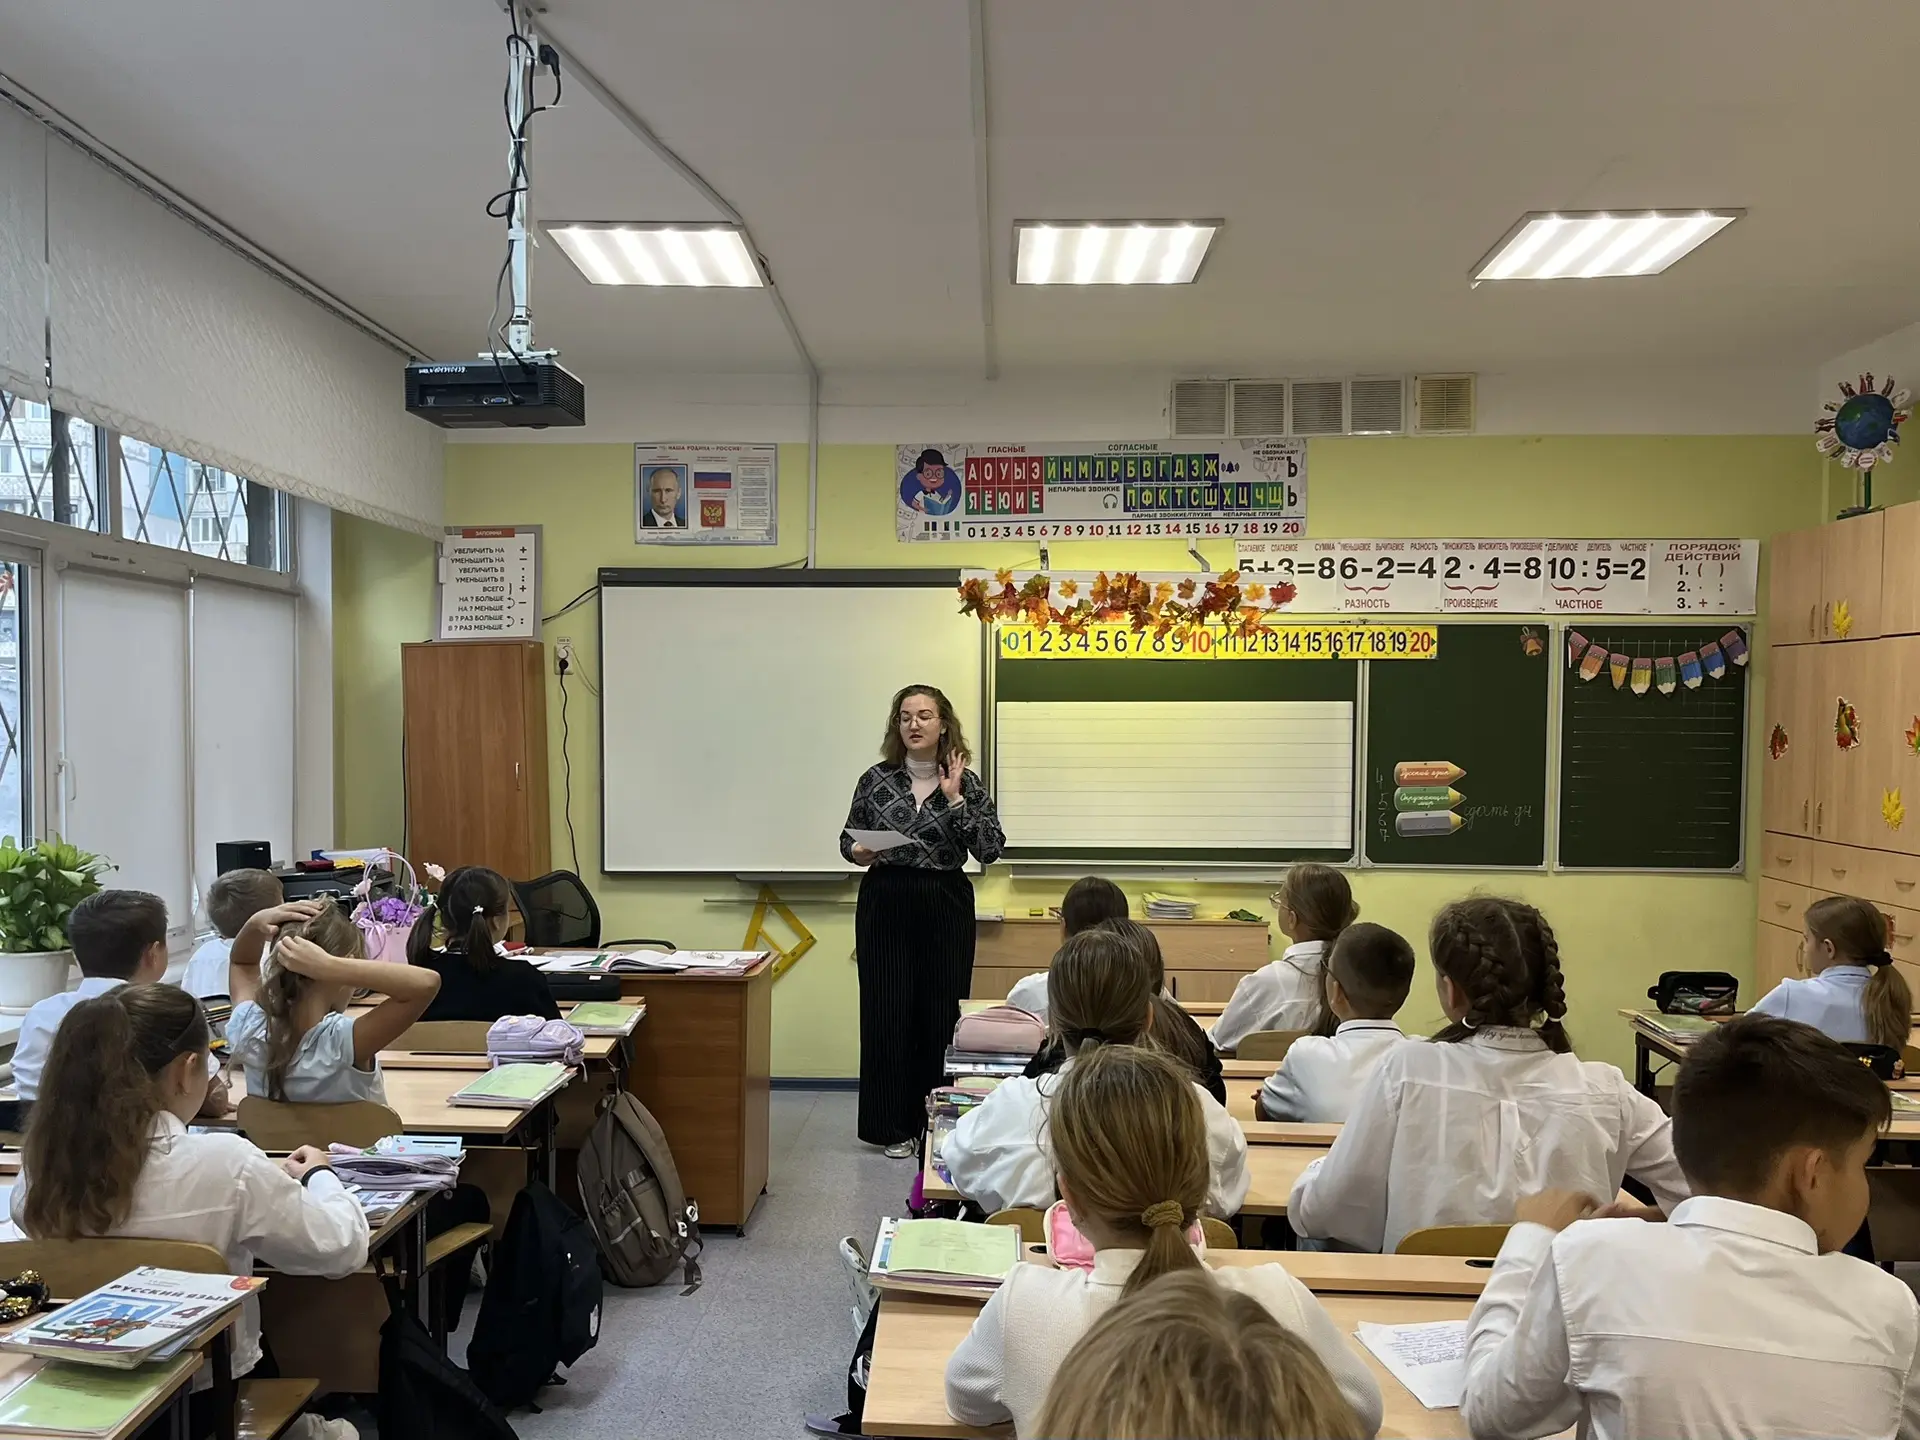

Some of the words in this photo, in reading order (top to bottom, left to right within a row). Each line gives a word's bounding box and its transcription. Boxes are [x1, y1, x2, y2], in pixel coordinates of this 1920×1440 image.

[1088, 485, 1121, 493] ЗВОНКИЕ
[968, 527, 976, 538] 0
[980, 527, 987, 537] 1
[991, 527, 999, 537] 2
[1003, 526, 1011, 537] 3
[1015, 526, 1024, 537] 4
[1027, 526, 1036, 536] 5
[1040, 525, 1048, 536] 6
[1052, 525, 1060, 536] 7
[1064, 525, 1072, 536] 8
[1076, 525, 1085, 536] 9
[1089, 525, 1104, 536] 10
[1108, 524, 1122, 535] 11
[1126, 524, 1141, 535] 12
[1145, 524, 1161, 535] 13
[1165, 523, 1181, 534] 14
[1185, 523, 1200, 534] 15
[1205, 523, 1220, 534] 16
[1224, 523, 1239, 534] 17
[1243, 523, 1258, 534] 18
[1263, 522, 1278, 533] 19
[1282, 522, 1299, 533] 20
[1315, 543, 1335, 551] СУММА
[1410, 542, 1438, 551] РАЗНОСТЬ
[1548, 542, 1579, 552] ДЕЛИМОЕ
[1586, 542, 1612, 552] ДЕЛИТЕЛЬ
[1620, 543, 1647, 552] ЧАСТНОЕ
[1669, 543, 1737, 551] ПОРЯДОК
[1664, 552, 1741, 562] ДЕЙСТВИЙ
[1344, 599, 1390, 609] РАЗНОСТЬ
[1443, 598, 1498, 609] ПРОИЗВЕДЕНИЕ
[1555, 599, 1603, 609] ЧАСТНОЕ
[1007, 632, 1019, 650] 0
[1023, 631, 1032, 650] 1
[1040, 630, 1053, 651] 2
[1058, 634, 1071, 652] 3
[1076, 631, 1090, 652] 4
[1096, 631, 1109, 652] 5
[1114, 631, 1127, 652] 6
[1134, 631, 1147, 652] 7
[1189, 631, 1211, 652] 10
[1221, 633, 1237, 652] 11
[1243, 634, 1257, 652] 12
[1261, 632, 1278, 652] 13
[1282, 632, 1300, 652] 14
[1304, 632, 1322, 652] 15
[1325, 632, 1343, 652] 16
[1346, 632, 1364, 652] 17
[1368, 632, 1385, 652] 18
[1388, 632, 1407, 652] 19
[1410, 632, 1430, 652] 20
[109, 1284, 184, 1298] РУССКИЙ
[184, 1293, 234, 1302] ЯЗЫК
[171, 1305, 210, 1319] 4
